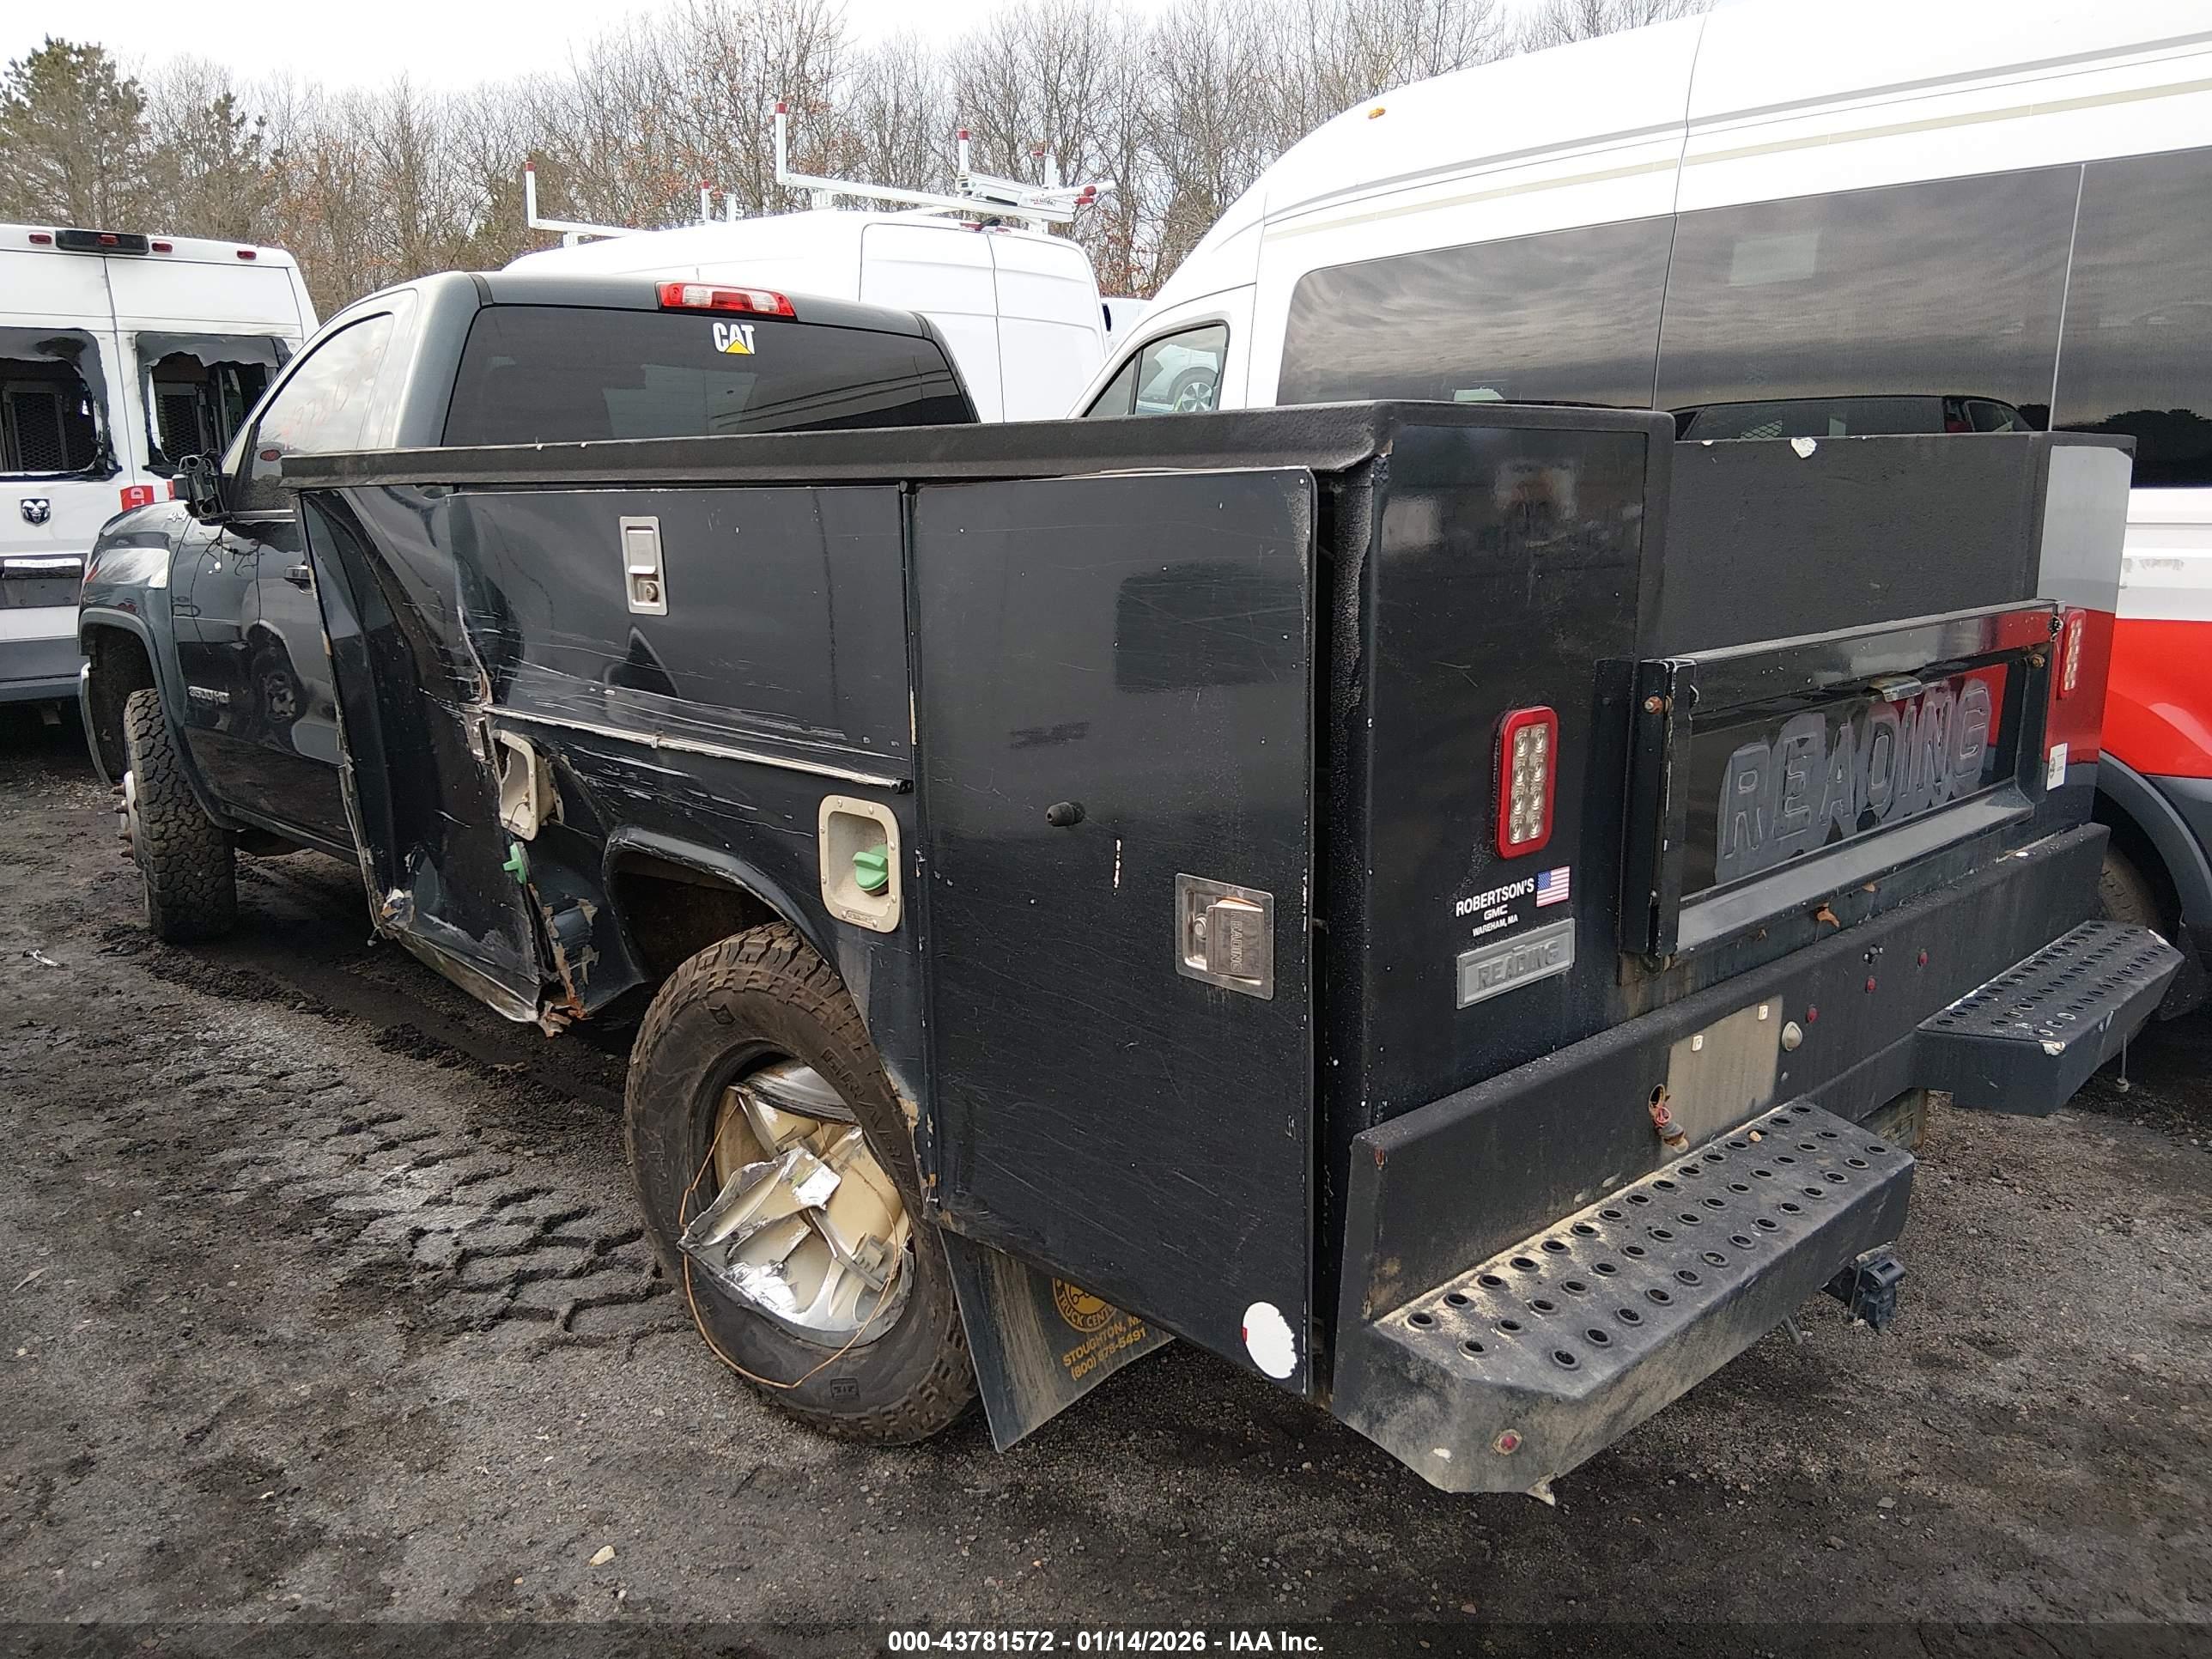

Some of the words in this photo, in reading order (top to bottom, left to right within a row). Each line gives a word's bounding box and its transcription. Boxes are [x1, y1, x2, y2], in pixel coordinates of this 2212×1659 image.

[712, 322, 755, 355] CAT
[131, 487, 144, 507] LD
[1719, 682, 1990, 866] READING
[1455, 878, 1534, 917] ROBERTSON'S
[1483, 904, 1508, 921] GMC
[1472, 919, 1508, 937] WAREHAM,
[1508, 914, 1519, 925] MA
[1477, 940, 1559, 989] READING
[1058, 1291, 1084, 1327] TRUCK
[1127, 1315, 1142, 1328] M
[1071, 1354, 1097, 1381] (800)
